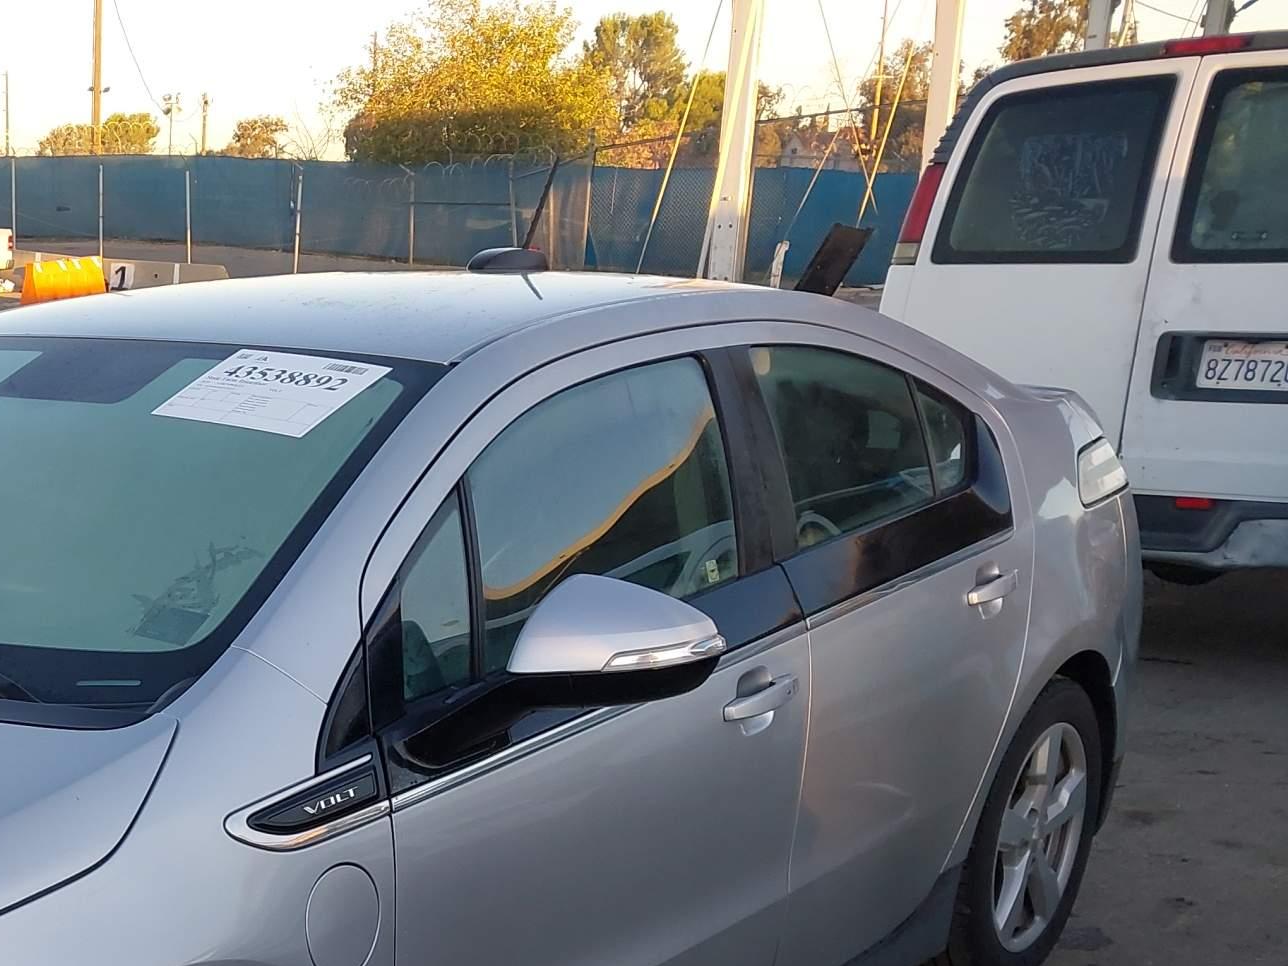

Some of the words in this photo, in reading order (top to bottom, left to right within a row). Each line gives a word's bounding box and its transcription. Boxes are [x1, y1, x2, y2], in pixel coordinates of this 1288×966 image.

[113, 266, 127, 290] 1
[223, 364, 348, 392] 43538892
[304, 786, 358, 815] VOLT
